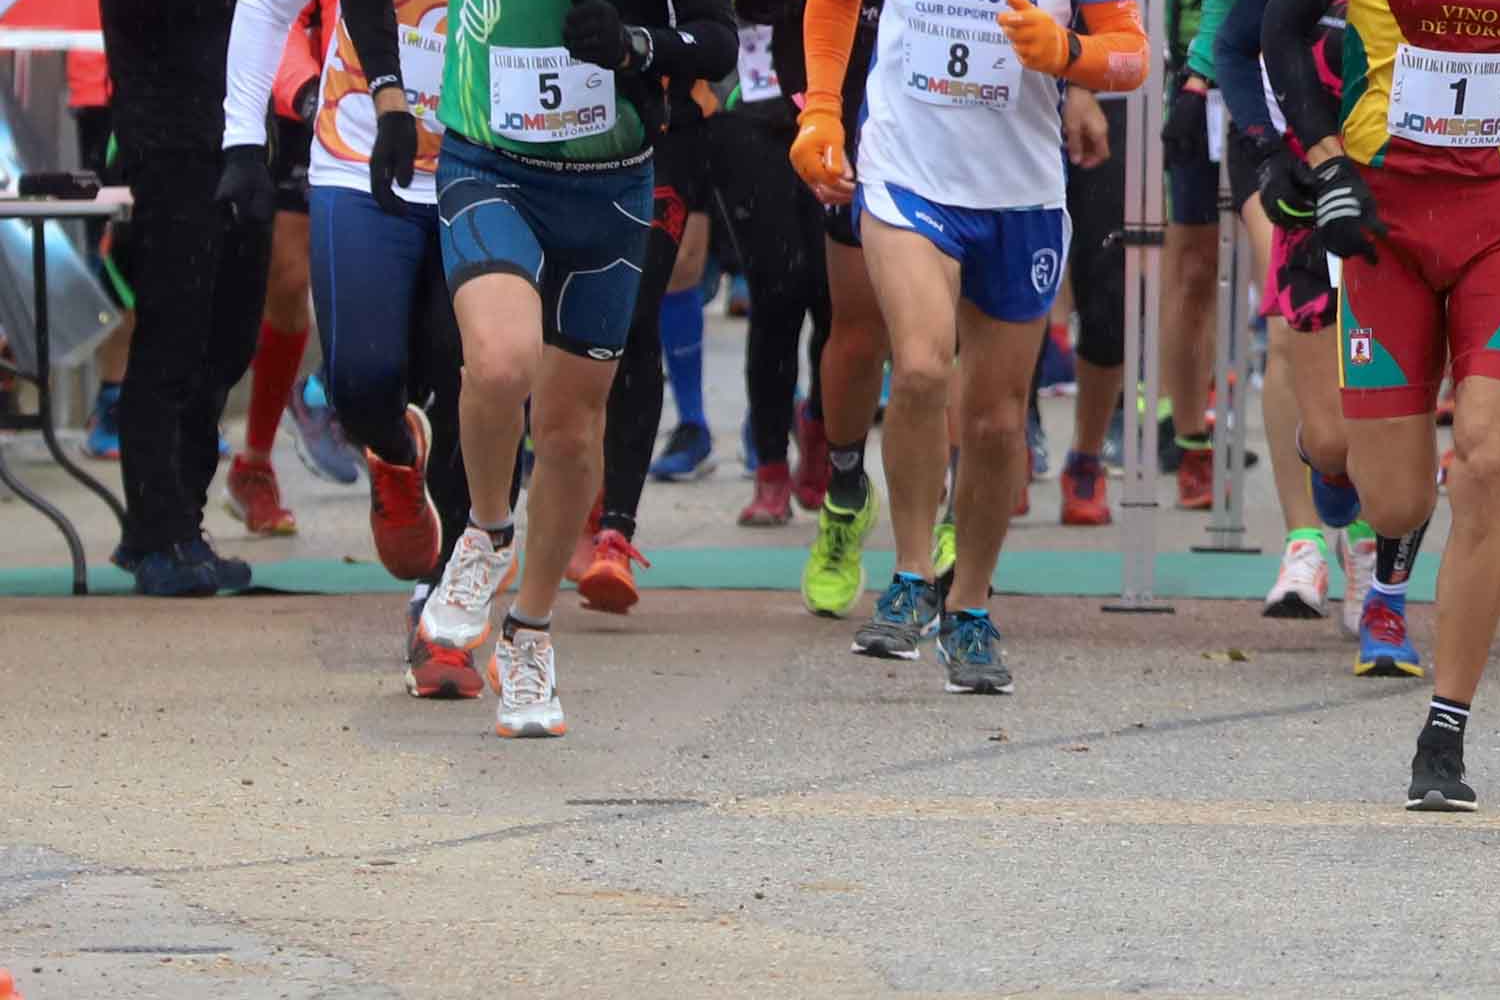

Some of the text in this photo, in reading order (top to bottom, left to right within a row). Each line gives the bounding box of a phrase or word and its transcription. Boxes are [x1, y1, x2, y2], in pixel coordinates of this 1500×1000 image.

[915, 0, 944, 15] CLUB
[1442, 4, 1498, 23] VINO
[1420, 19, 1447, 34] DE
[946, 43, 970, 77] 8
[1446, 60, 1472, 74] CROSS
[539, 73, 562, 110] 5
[908, 71, 1009, 101] JOMISAGA
[1450, 77, 1467, 115] 1
[500, 105, 606, 131] JOMISAGA
